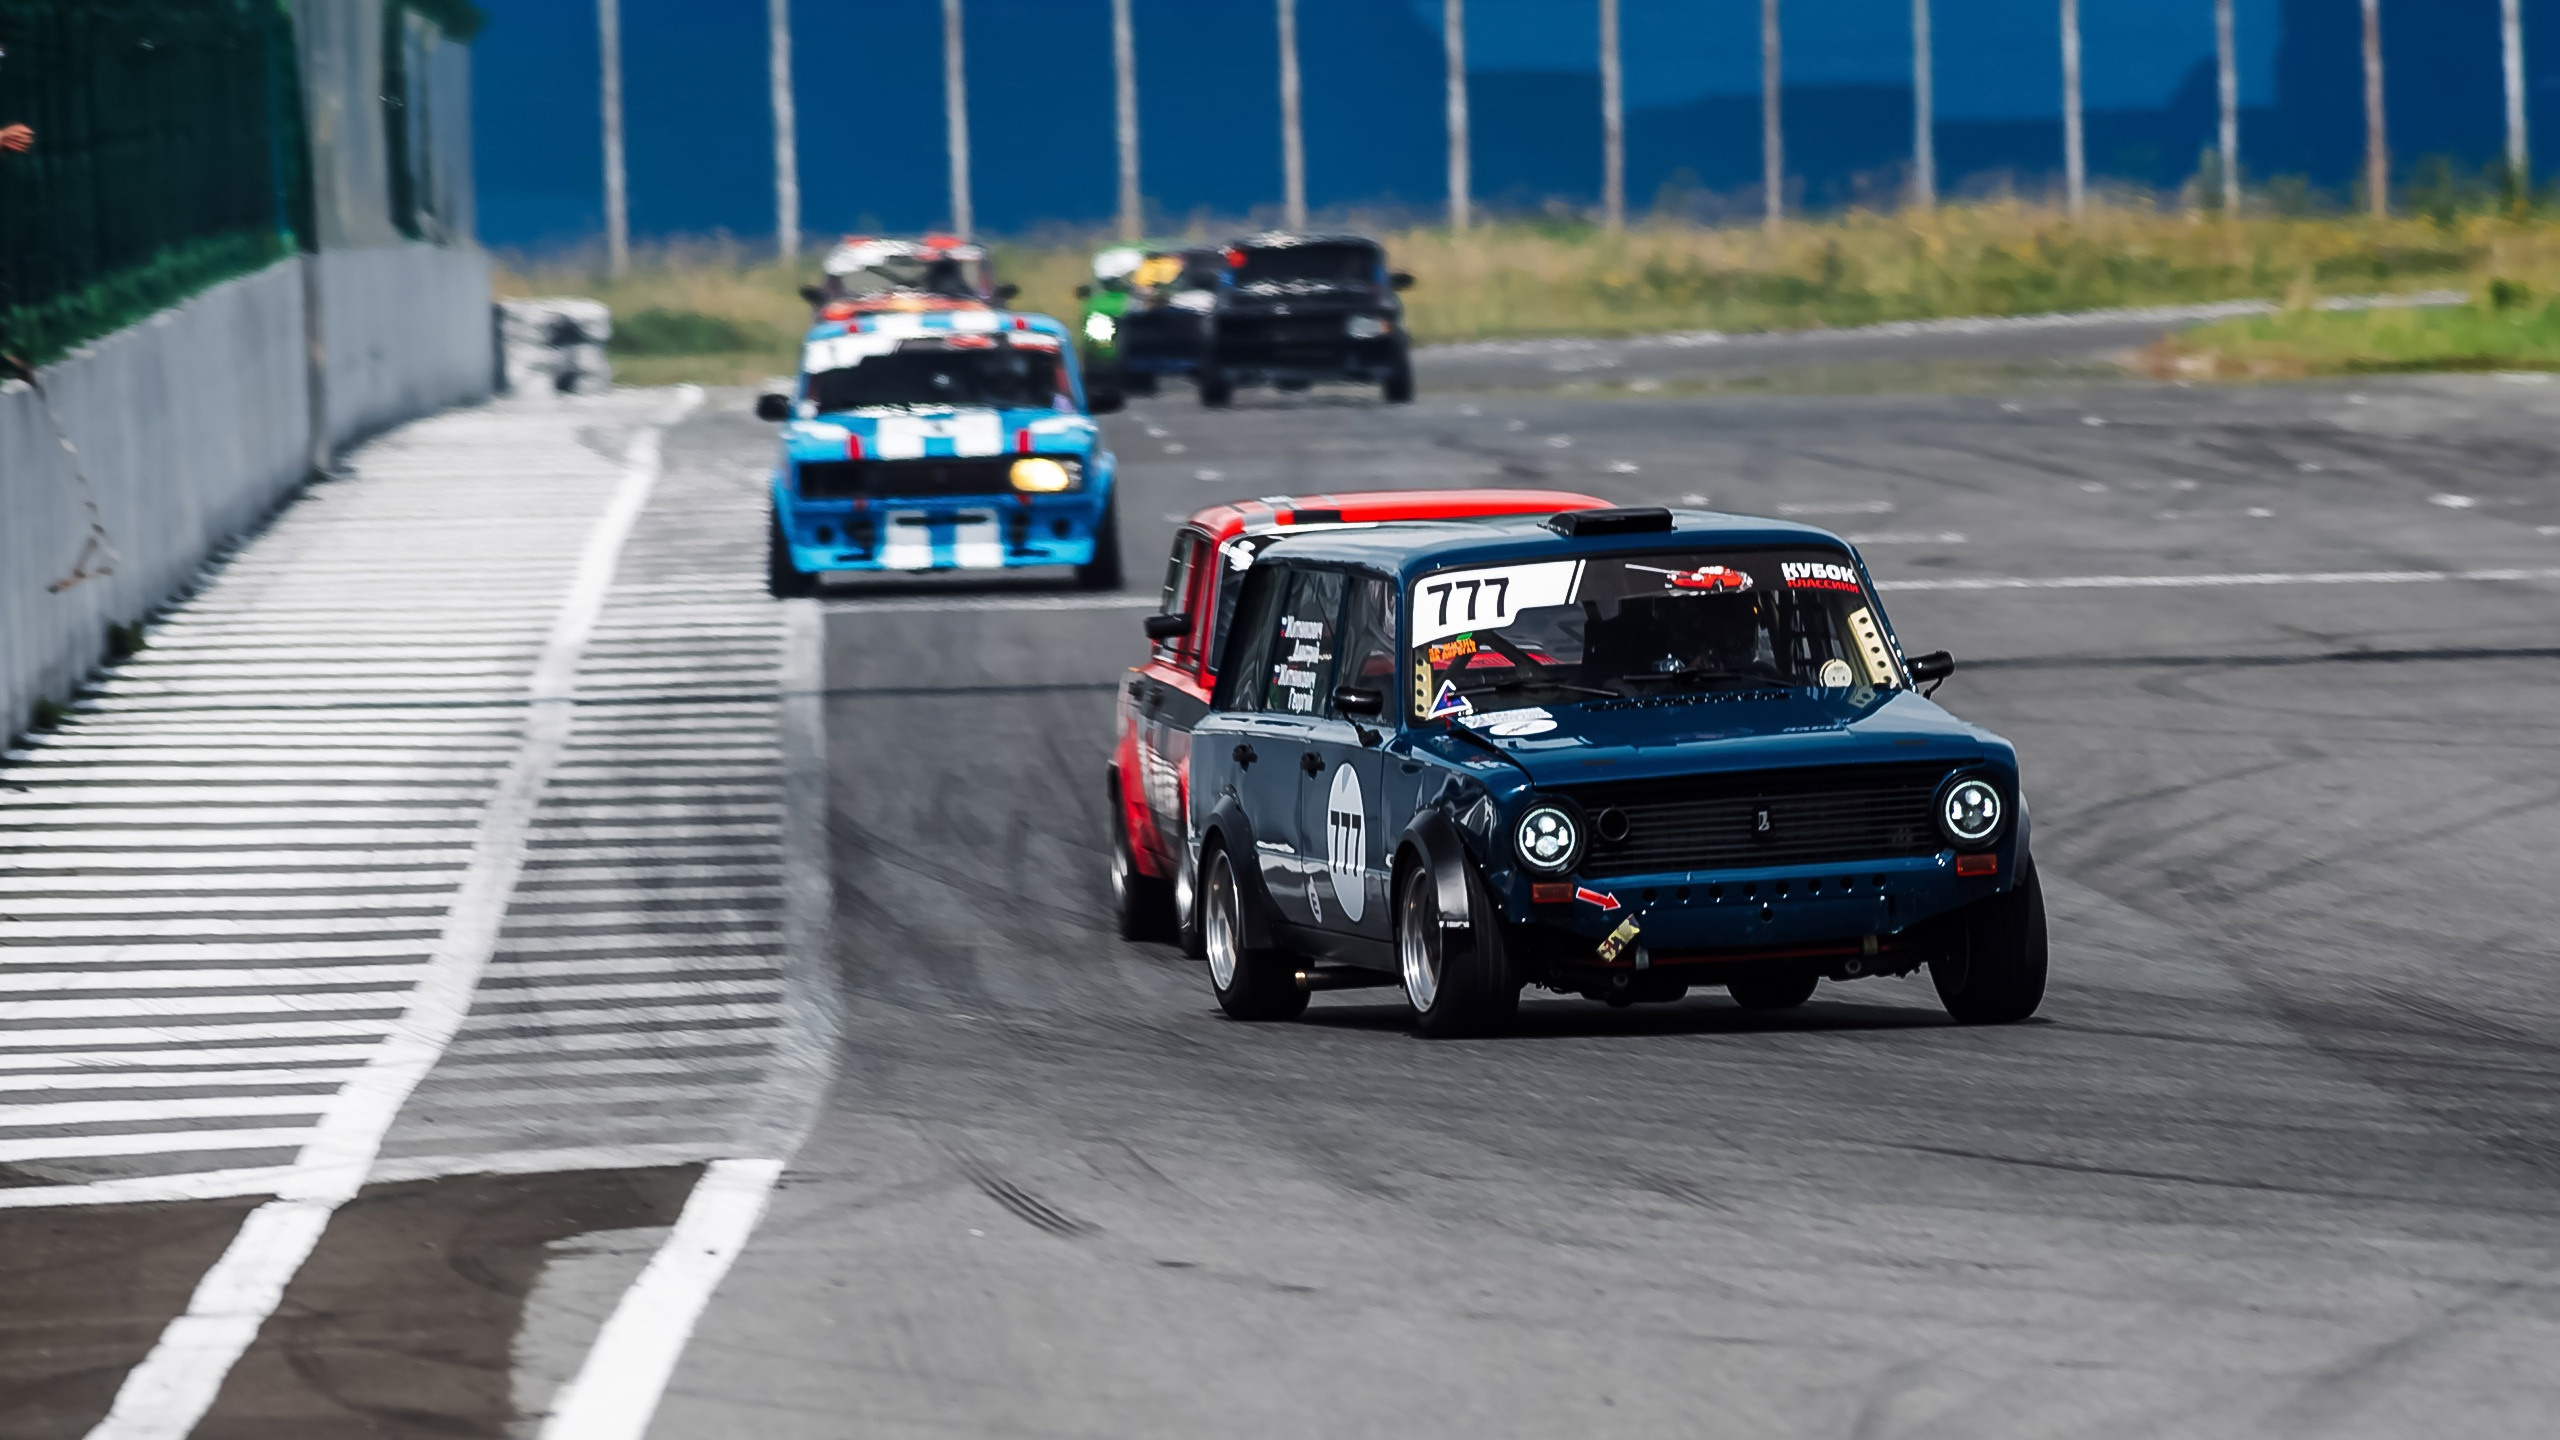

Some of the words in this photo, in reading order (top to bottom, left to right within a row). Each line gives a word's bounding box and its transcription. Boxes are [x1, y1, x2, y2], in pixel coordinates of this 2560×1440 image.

[1781, 562, 1856, 583] КУБОК
[1427, 577, 1509, 626] 777
[1331, 810, 1361, 877] 777
